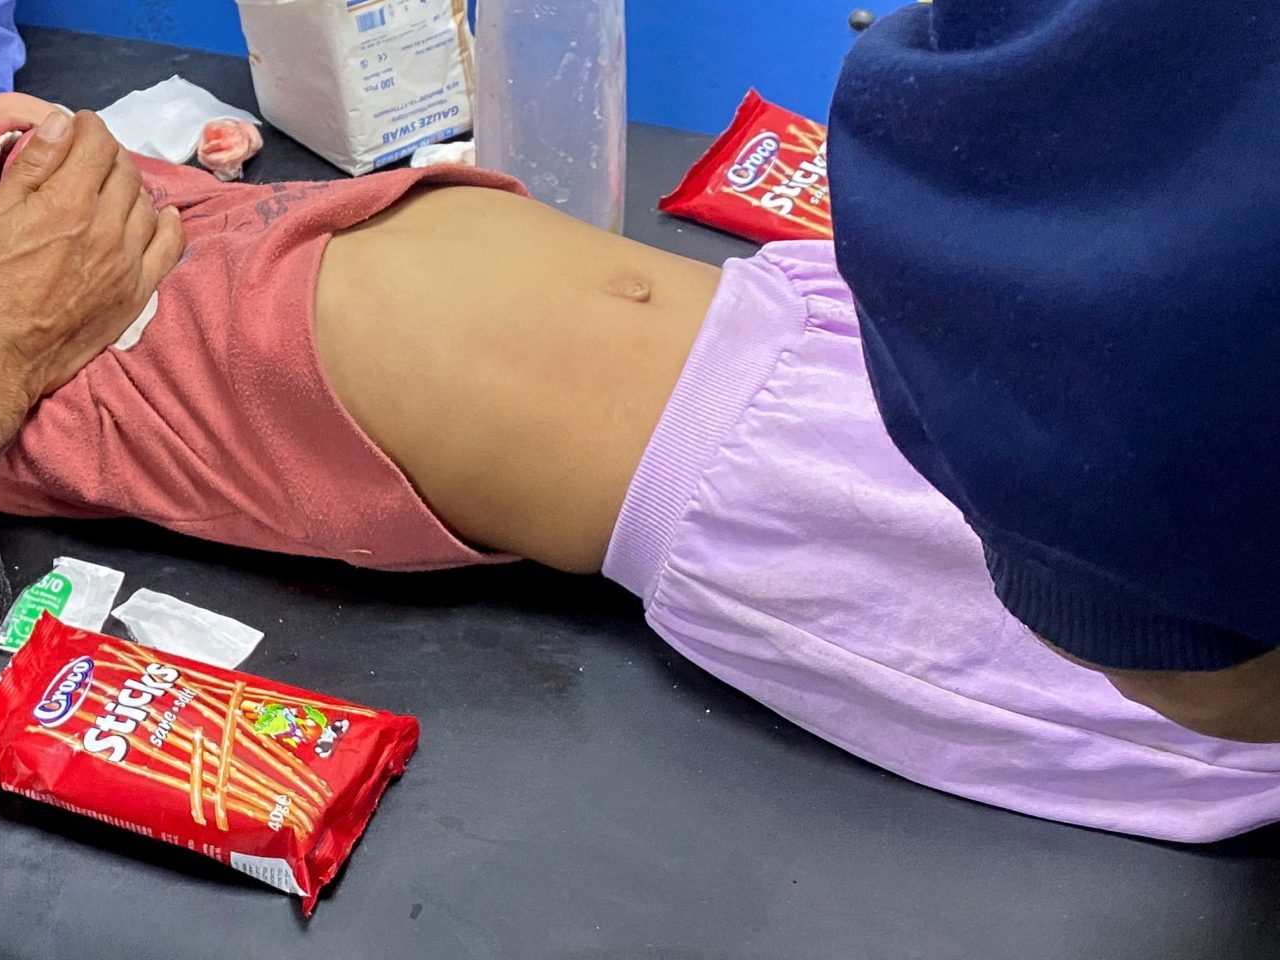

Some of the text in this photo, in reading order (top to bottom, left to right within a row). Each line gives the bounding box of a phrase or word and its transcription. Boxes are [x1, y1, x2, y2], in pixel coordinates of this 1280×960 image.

[380, 77, 396, 90] 100
[382, 121, 416, 144] SWAB
[418, 105, 459, 129] GAUZE
[727, 137, 778, 185] Croco
[761, 141, 827, 216] Stick
[33, 659, 93, 722] Croco
[83, 662, 181, 762] Sticks
